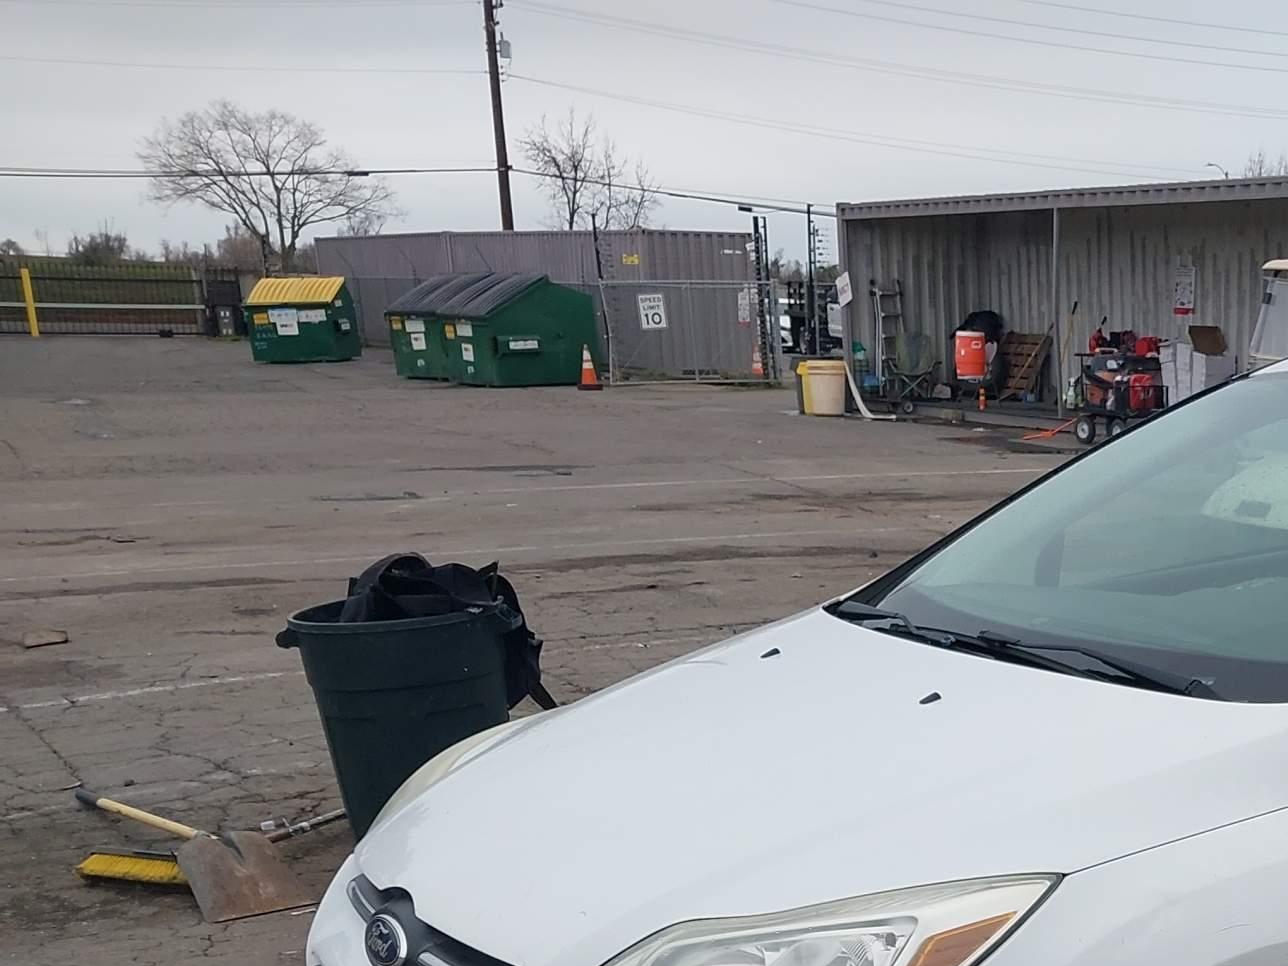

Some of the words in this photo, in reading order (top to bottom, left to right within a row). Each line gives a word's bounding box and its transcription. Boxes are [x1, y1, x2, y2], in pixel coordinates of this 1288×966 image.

[640, 296, 662, 304] SPEED
[645, 312, 662, 326] 10
[367, 921, 393, 958] Ford
